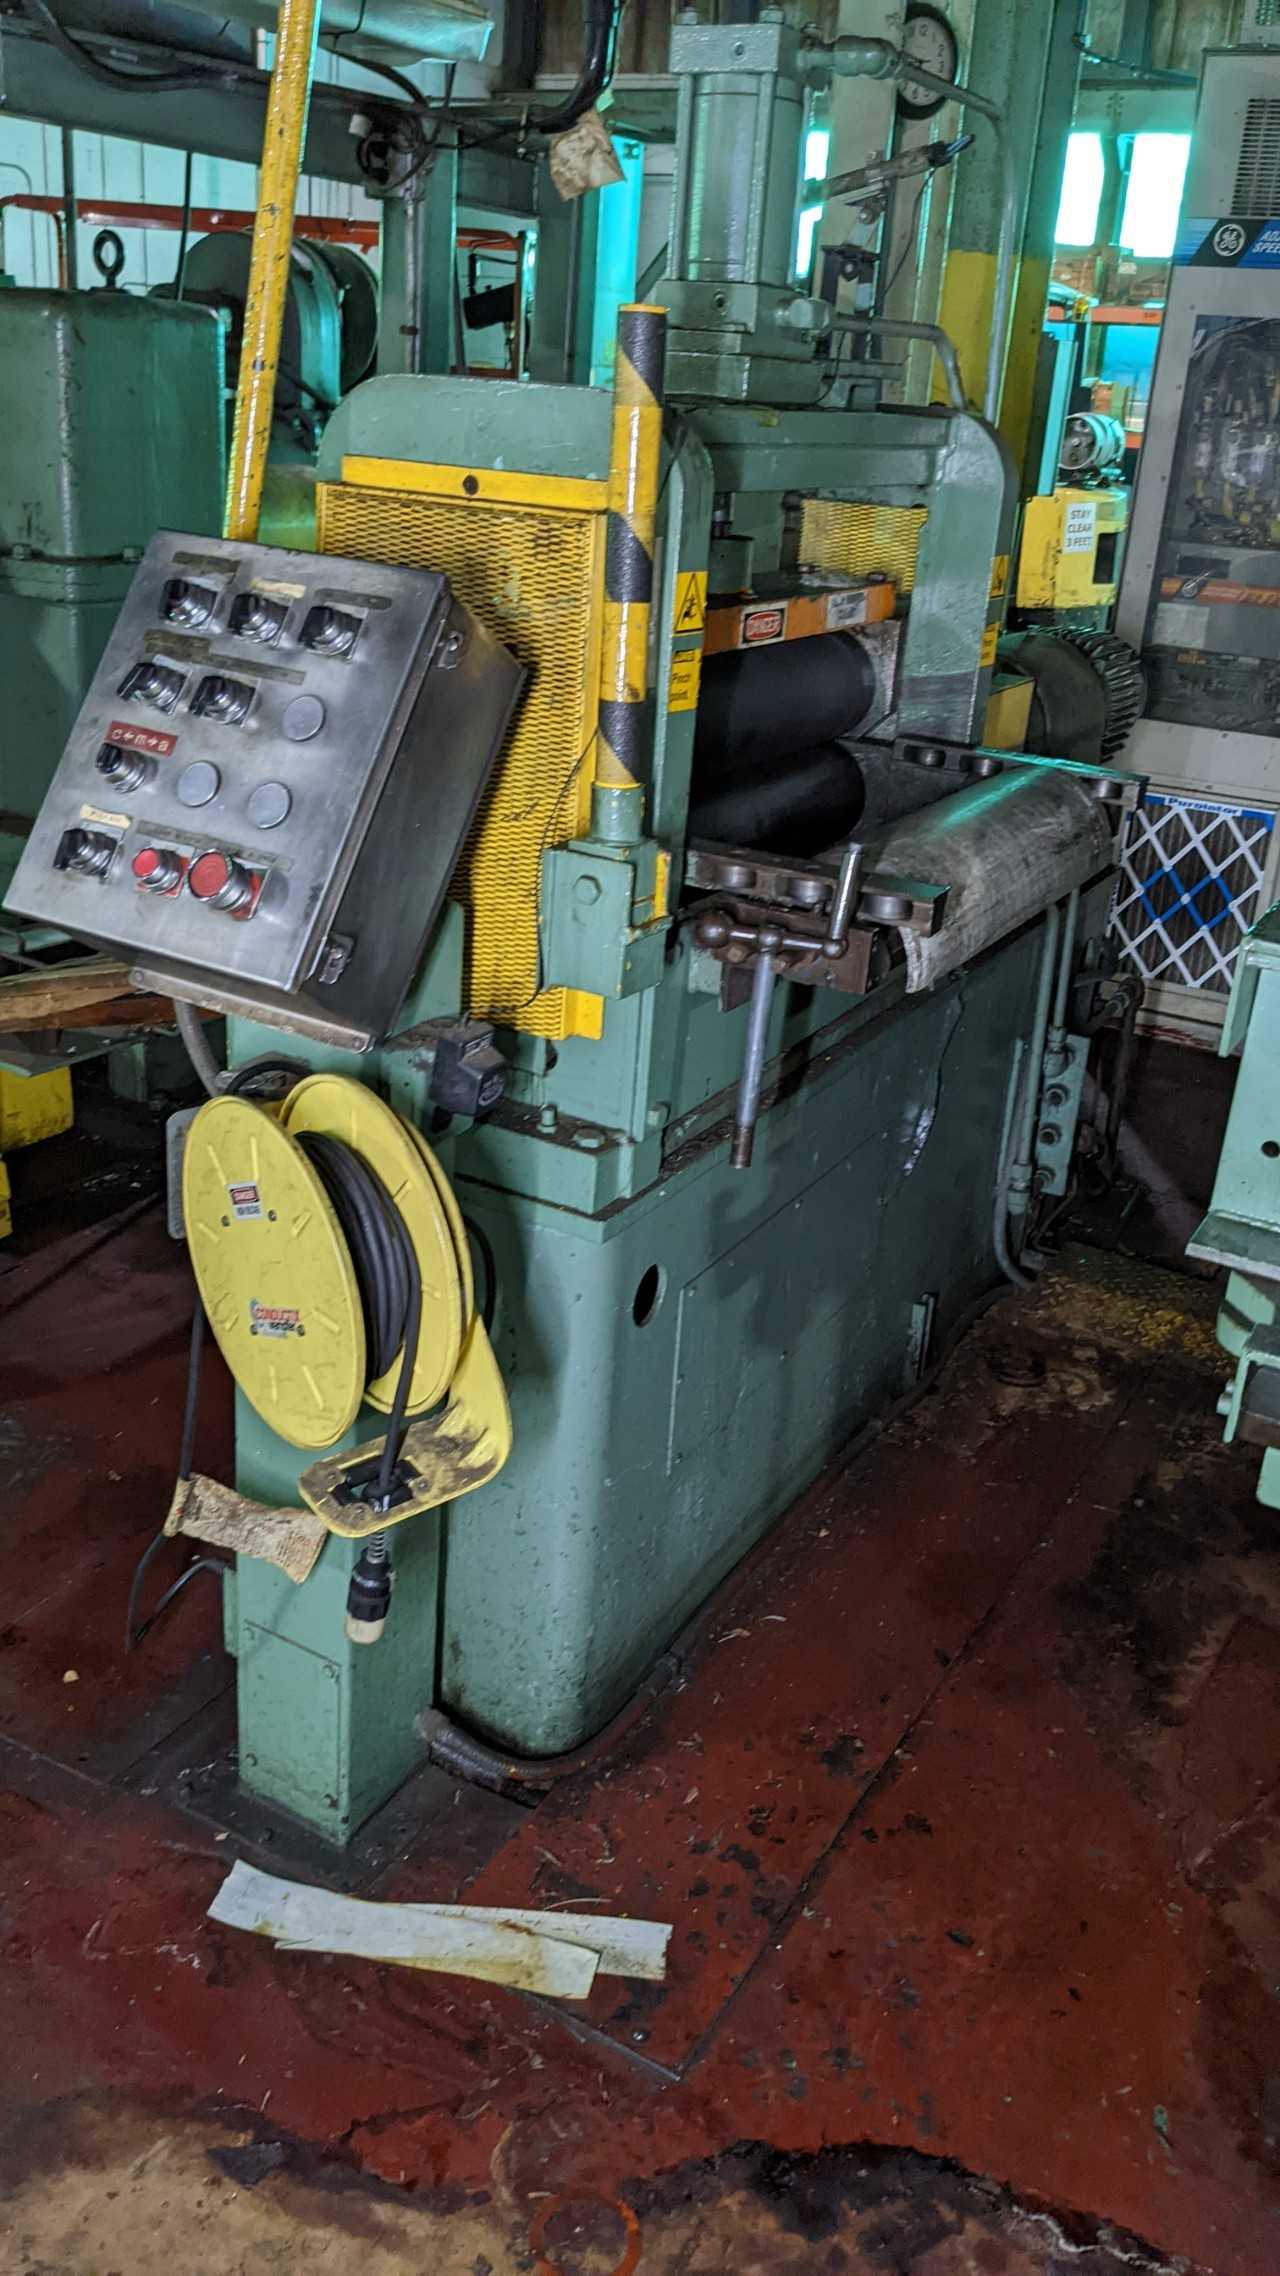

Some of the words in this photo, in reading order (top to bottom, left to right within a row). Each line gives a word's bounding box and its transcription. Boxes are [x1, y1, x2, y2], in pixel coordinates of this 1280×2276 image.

[1071, 509, 1091, 520] STAY
[1067, 523, 1092, 533] CLEAR
[1073, 537, 1092, 547] FEET
[1166, 797, 1240, 815] Purolator
